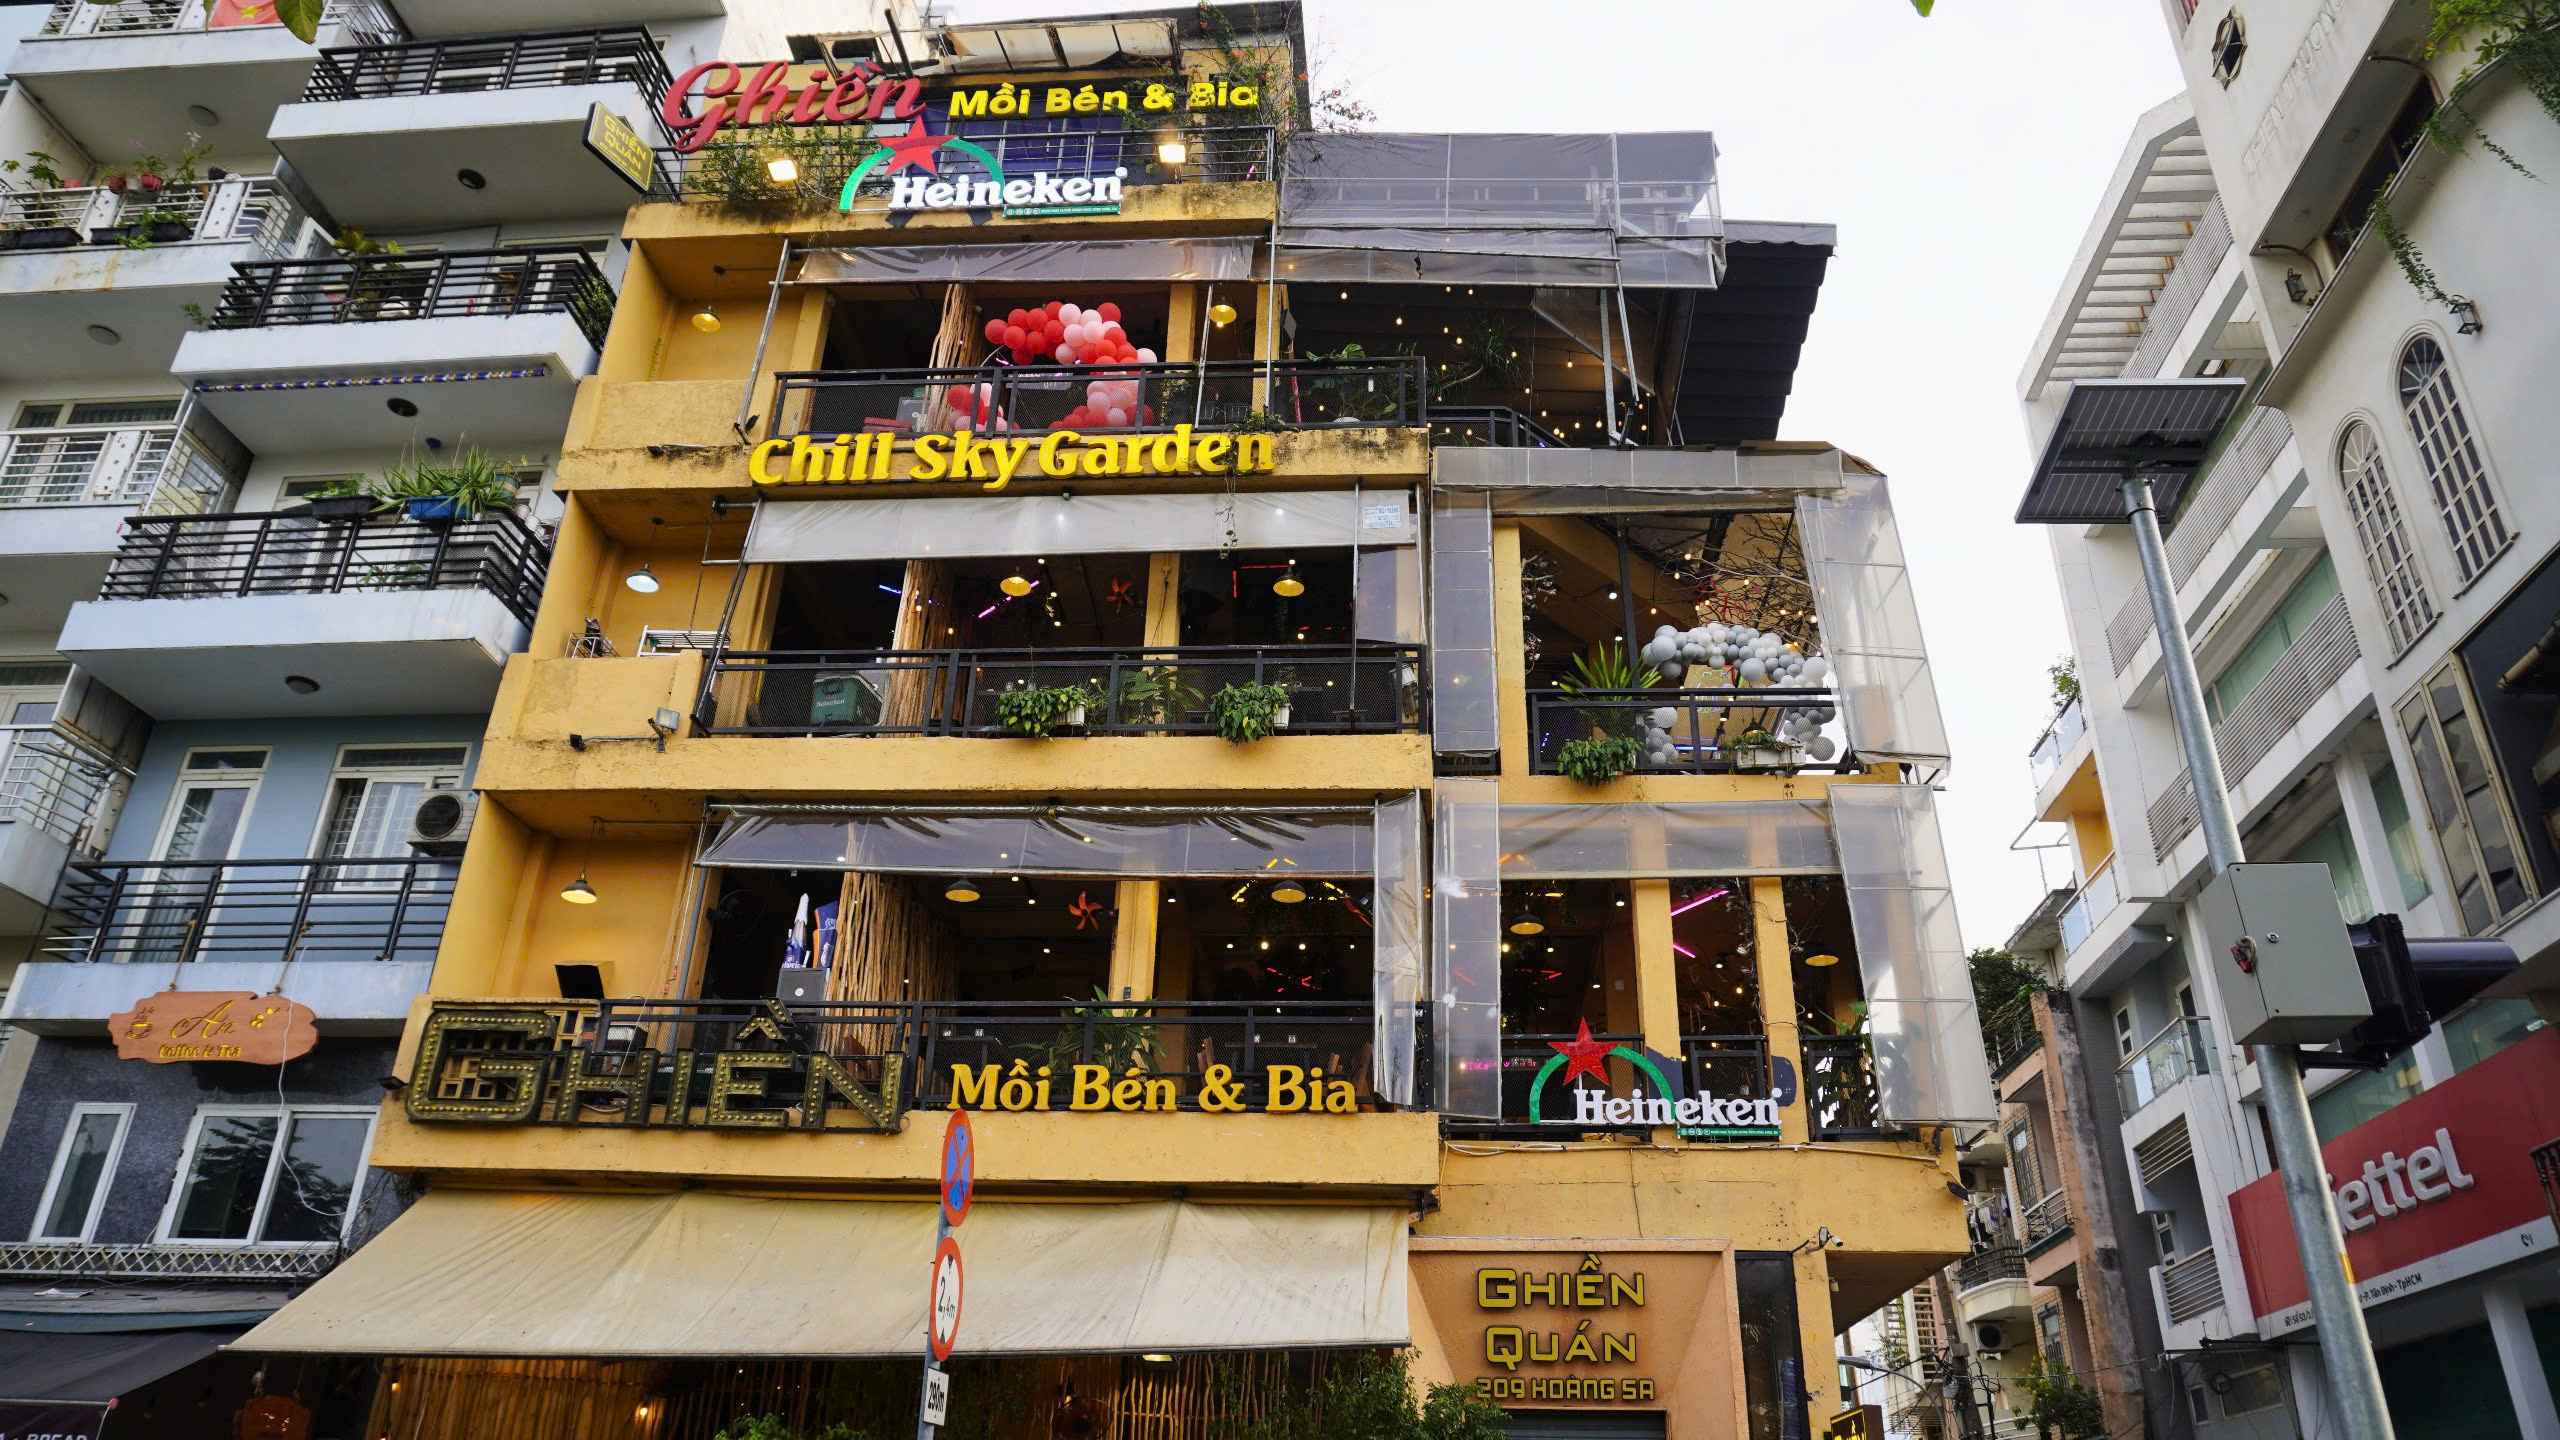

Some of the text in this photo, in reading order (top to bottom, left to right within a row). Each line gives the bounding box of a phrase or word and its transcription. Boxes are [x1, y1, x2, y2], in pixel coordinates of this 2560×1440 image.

[949, 80, 1260, 119] Mồi Bén & Bia
[887, 170, 1126, 209] Heineken
[748, 423, 1276, 491] Chill Sky Garden
[405, 998, 905, 1133] GHIỀN
[946, 1058, 1359, 1114] Mồi Bén & Bia
[1572, 1088, 1783, 1127] Heineken
[2327, 1127, 2475, 1235] iettel
[1477, 1253, 1646, 1309] GHIỀN
[1486, 1319, 1638, 1372] QUÁN
[1476, 1376, 1526, 1400] 209
[1621, 1378, 1655, 1400] SA
